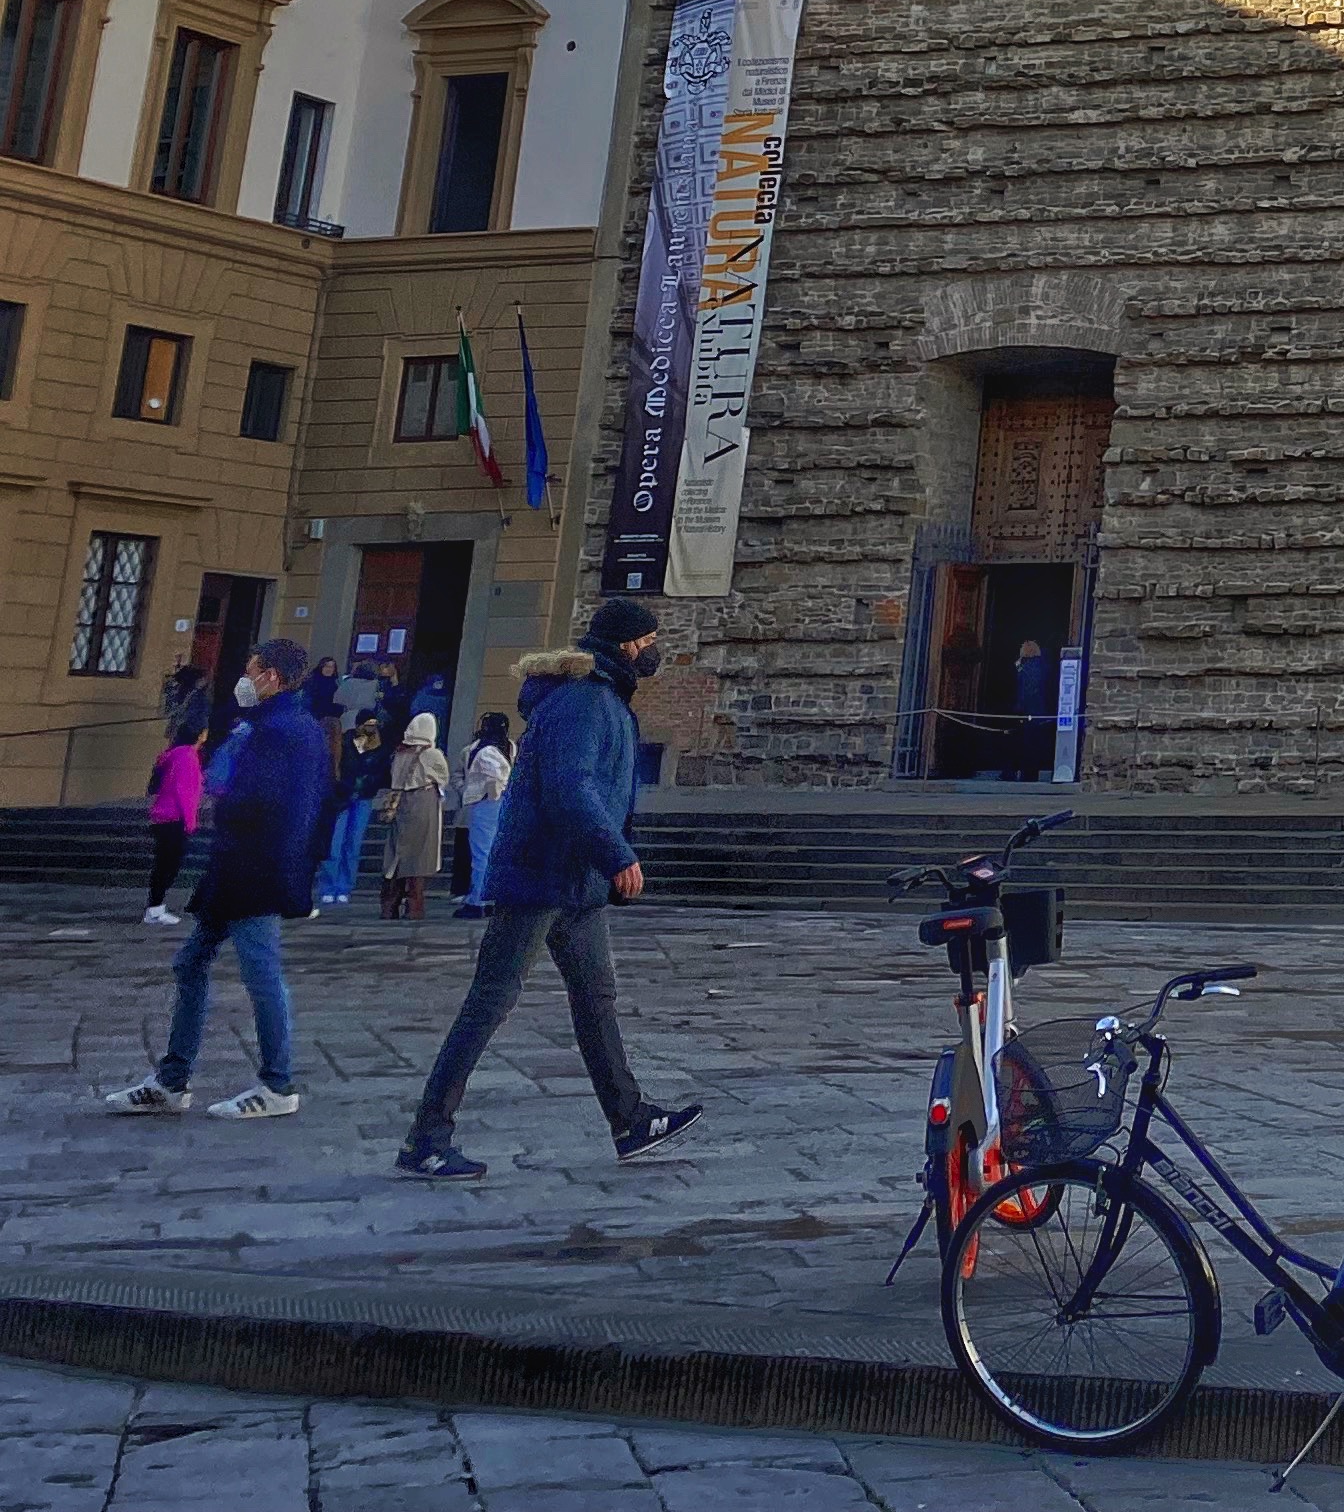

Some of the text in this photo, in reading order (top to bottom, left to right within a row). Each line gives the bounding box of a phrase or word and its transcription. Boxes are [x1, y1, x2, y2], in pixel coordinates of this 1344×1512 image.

[754, 136, 783, 224] collecta
[644, 300, 678, 418] Medicea
[702, 230, 765, 469] NATURA
[633, 427, 663, 512] Opera
